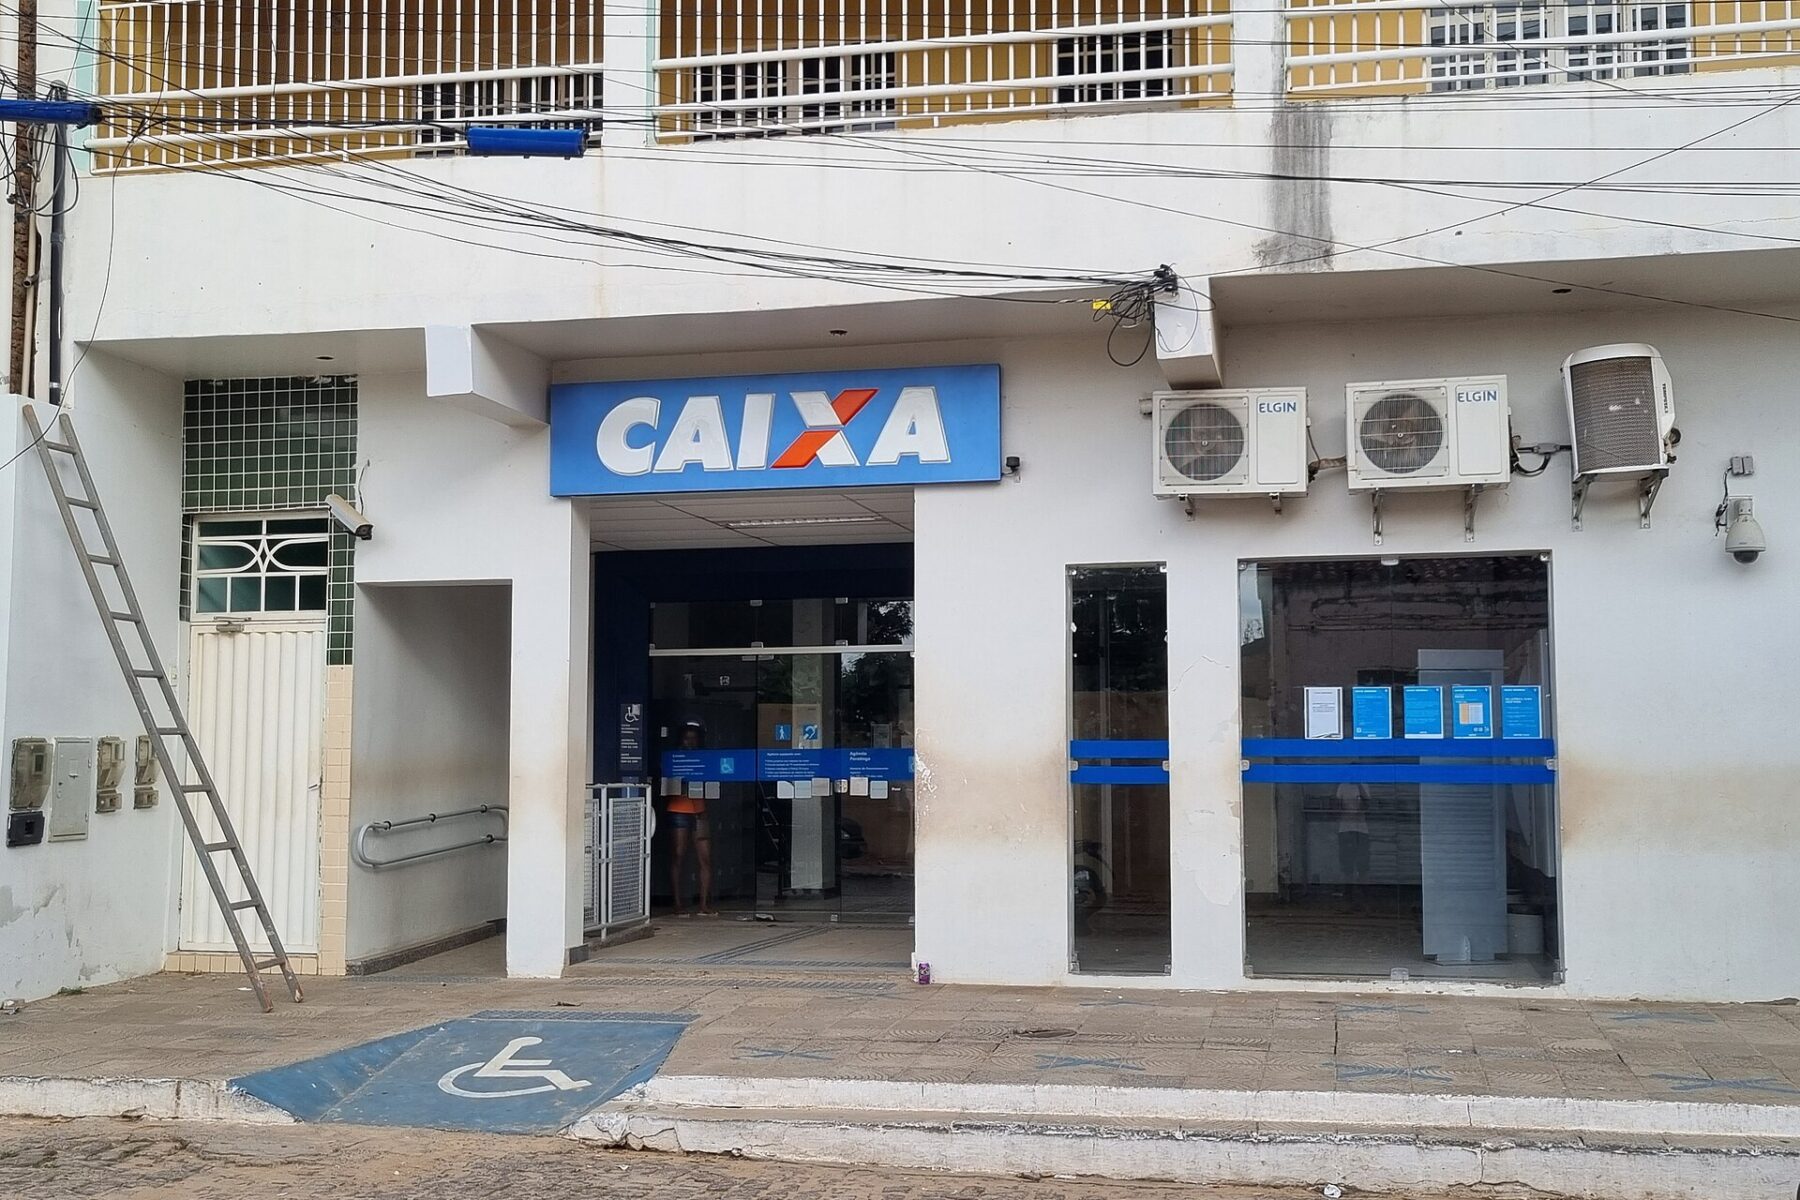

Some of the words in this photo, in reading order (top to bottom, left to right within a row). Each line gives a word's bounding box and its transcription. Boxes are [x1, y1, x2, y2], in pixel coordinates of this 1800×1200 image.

[1458, 390, 1497, 402] ELGIN
[1259, 402, 1296, 413] ELGIN
[596, 386, 951, 476] CAIXA
